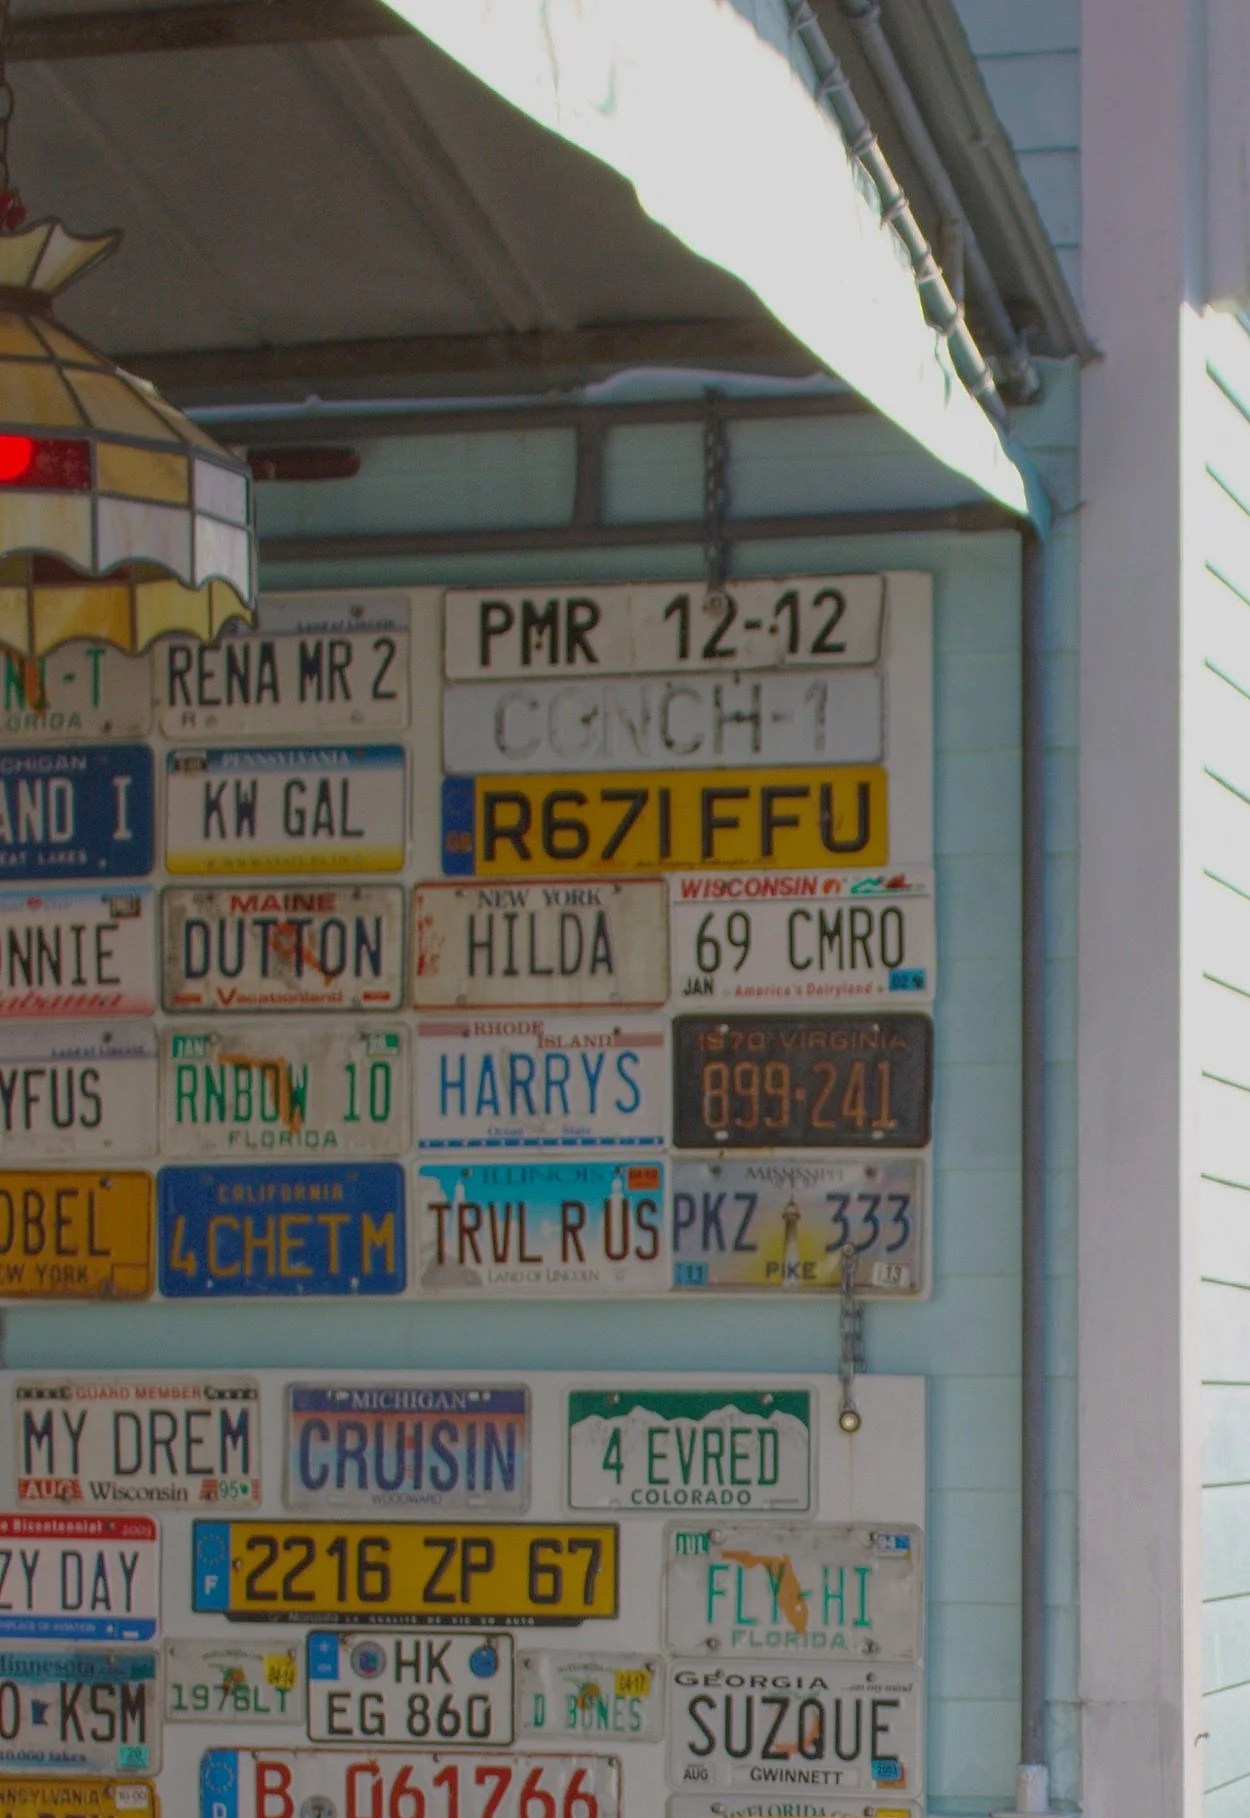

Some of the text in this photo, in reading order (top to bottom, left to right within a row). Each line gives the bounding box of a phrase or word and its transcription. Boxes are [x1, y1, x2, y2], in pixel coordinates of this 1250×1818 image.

[479, 597, 600, 668] PMR
[167, 636, 398, 707] RENA MR 2
[203, 776, 365, 840] KW GAL
[701, 781, 872, 860] FFU
[477, 888, 602, 908] NEW YORK
[680, 875, 818, 899] WISCONSIN
[229, 892, 338, 914] MAINE
[183, 915, 383, 980] DUTTON
[468, 911, 614, 977] HILDA
[696, 909, 751, 974] 69
[683, 976, 714, 996] JAN
[734, 981, 873, 998] America's Dairyland
[216, 987, 344, 1008] Vacationland
[473, 1020, 545, 1036] RHODE
[536, 1032, 615, 1049] ISLAND
[695, 1031, 911, 1052] 1970 VIRGINIA
[342, 1060, 392, 1124] 10
[439, 1050, 641, 1117] HARRYS
[227, 1129, 339, 1150] FLORIDA
[481, 1166, 606, 1185] ILLINOIS
[217, 1183, 343, 1203] CALIFORNIA
[427, 1197, 661, 1266] TRVL R US
[674, 1191, 912, 1255] PKZ 333
[765, 1261, 817, 1279] PIKE
[74, 1386, 201, 1399] GUARD MEMBER
[351, 1390, 468, 1409] MICHIGAN
[22, 1407, 250, 1477] MY DREM
[299, 1417, 517, 1492] CRUISIN
[601, 1426, 781, 1486] 4 EVRED
[25, 1480, 74, 1498] AUG
[88, 1480, 189, 1502] Wisconsin
[370, 1493, 443, 1506] WOODWARD
[631, 1488, 752, 1505] COLORADO
[60, 1549, 139, 1613] DAY
[245, 1535, 603, 1606] 2216 ZP 67
[204, 1574, 220, 1596] F
[731, 1630, 849, 1652] FLORIDA
[394, 1639, 453, 1684] HK
[674, 1670, 829, 1691] GEORGIA
[60, 1680, 147, 1743] KSM
[327, 1691, 492, 1740] EG 860
[533, 1693, 546, 1728] D
[686, 1694, 900, 1763] SUZQUE
[682, 1766, 709, 1782] AUG
[749, 1766, 844, 1787] GWINNETT
